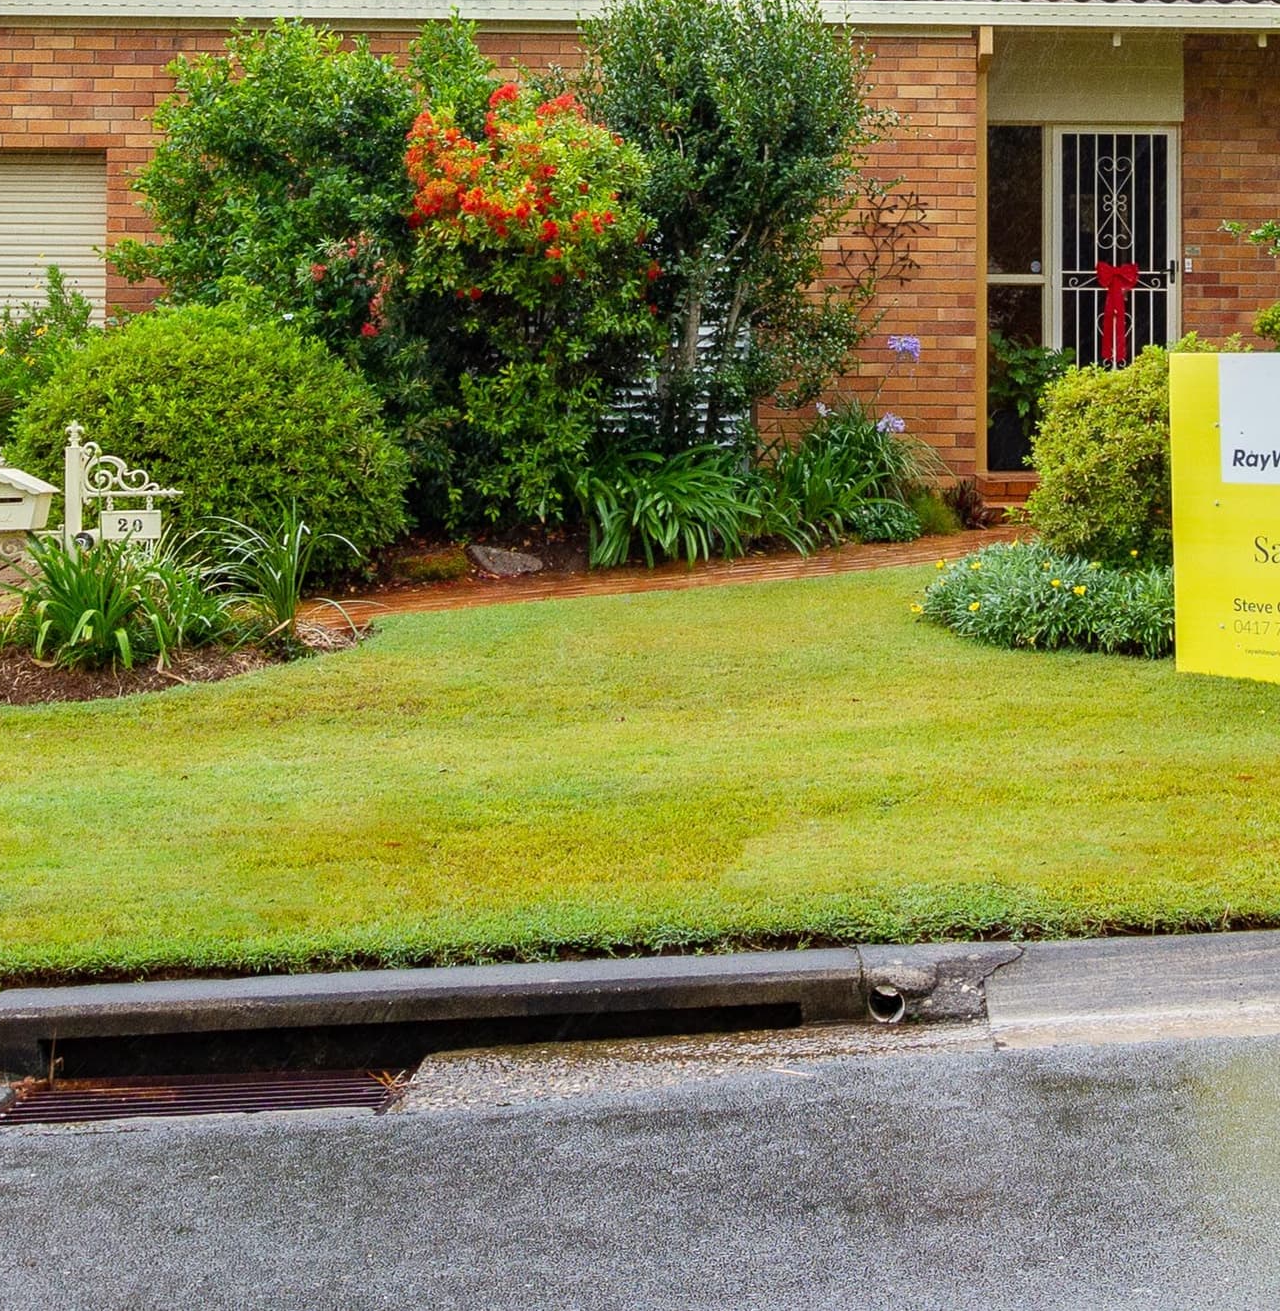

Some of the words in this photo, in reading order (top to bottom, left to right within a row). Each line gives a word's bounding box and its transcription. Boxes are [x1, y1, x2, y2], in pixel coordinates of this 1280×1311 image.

[117, 518, 143, 533] 20
[1233, 597, 1273, 614] Steve
[1233, 619, 1270, 635] 0417
